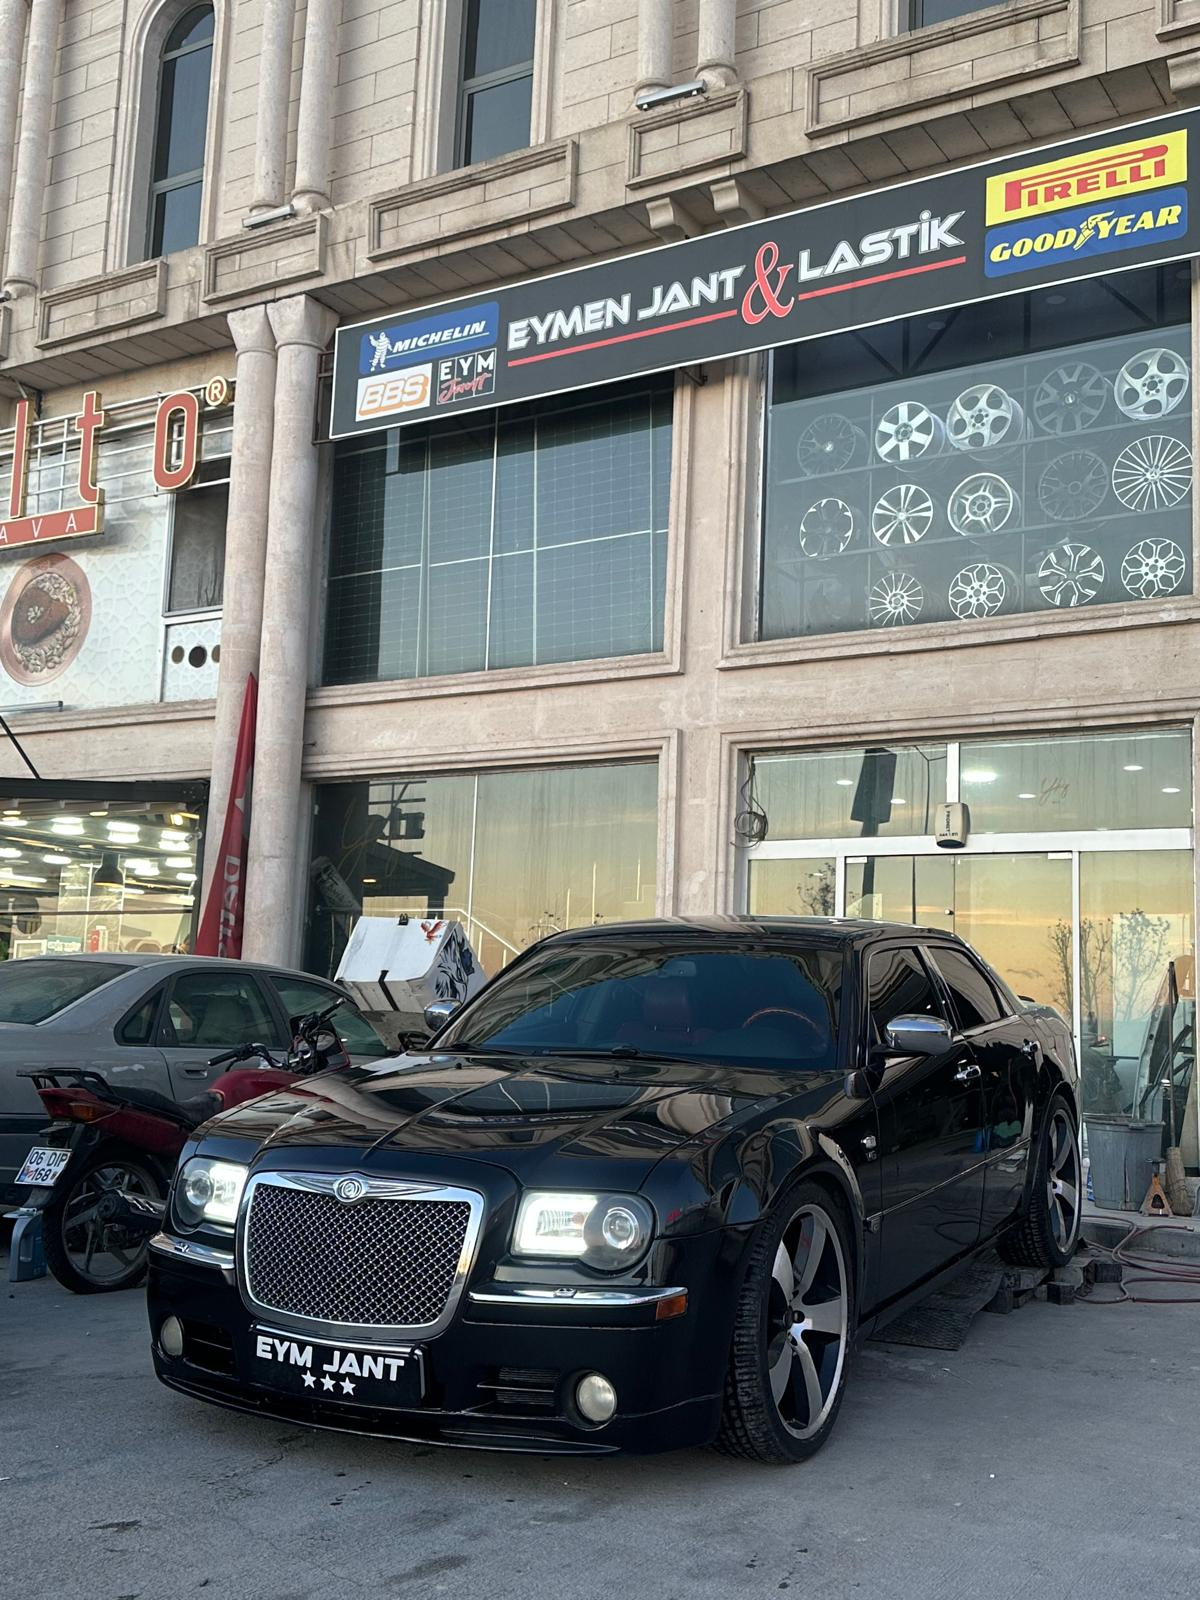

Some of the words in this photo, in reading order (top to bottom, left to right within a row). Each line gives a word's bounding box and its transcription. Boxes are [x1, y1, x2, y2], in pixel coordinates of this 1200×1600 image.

[1004, 144, 1169, 212] PIRELLI
[506, 293, 632, 352] EYMEN
[637, 264, 746, 321] JANT
[741, 240, 795, 326] &
[392, 320, 486, 353] MICHELIN
[440, 351, 495, 381] EYM
[358, 373, 430, 417] BBS
[29, 1151, 46, 1166] 06
[46, 1151, 69, 1168] DIP
[31, 1167, 52, 1182] 168
[256, 1335, 313, 1368] EYM
[322, 1350, 405, 1382] JANT
